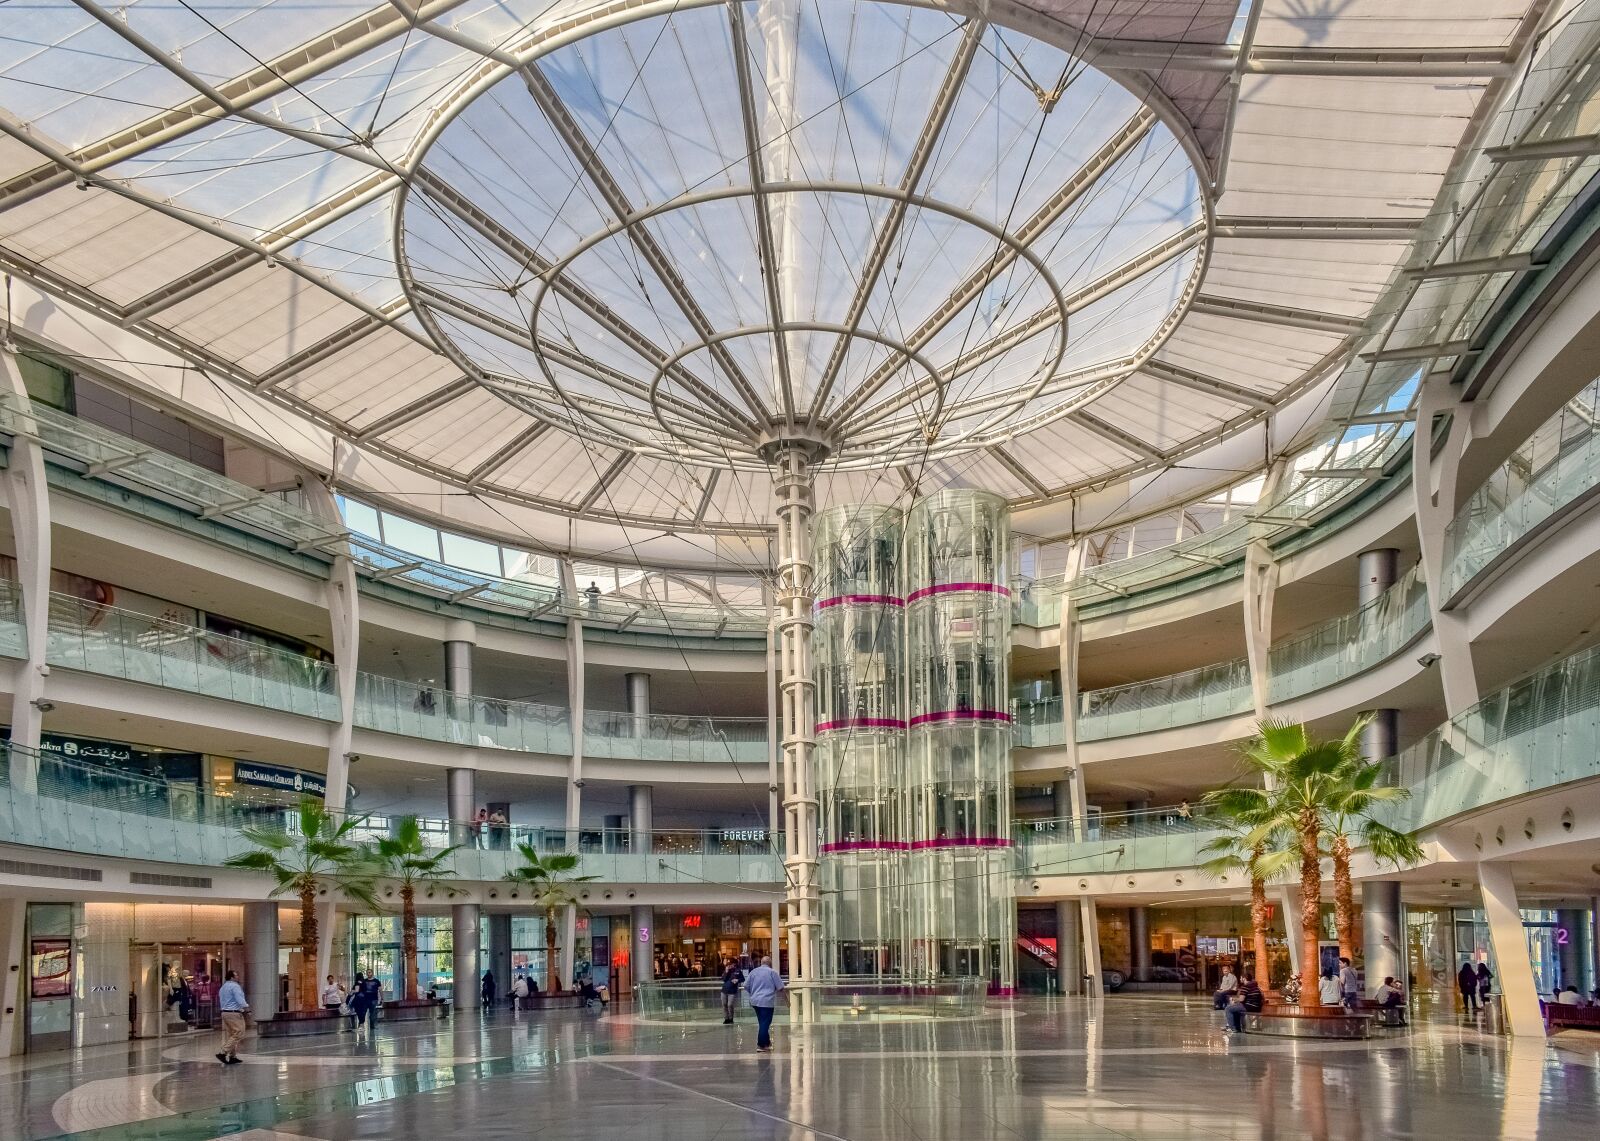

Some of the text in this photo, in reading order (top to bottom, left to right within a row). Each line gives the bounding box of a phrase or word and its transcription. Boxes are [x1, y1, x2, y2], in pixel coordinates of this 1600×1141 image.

[39, 741, 61, 752] akra
[723, 830, 765, 841] FOREVER
[639, 927, 649, 942] 3
[1557, 928, 1568, 944] 2
